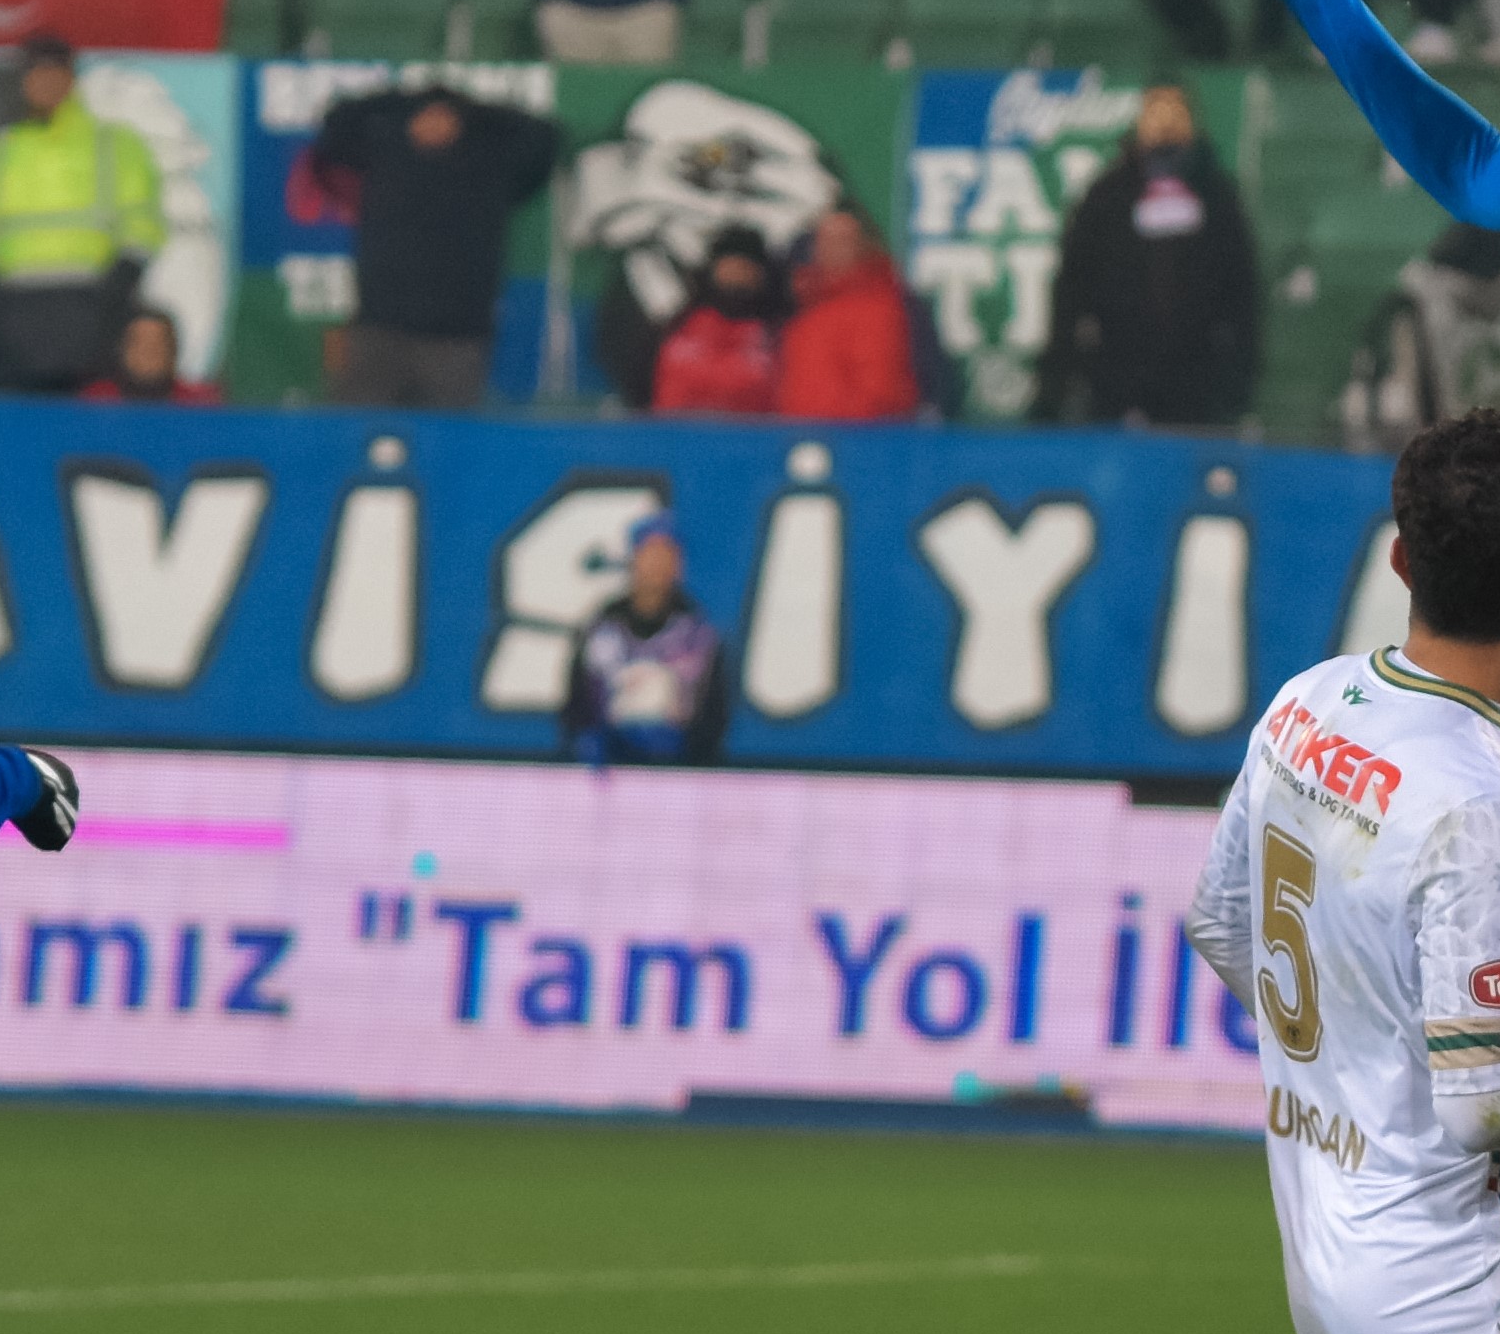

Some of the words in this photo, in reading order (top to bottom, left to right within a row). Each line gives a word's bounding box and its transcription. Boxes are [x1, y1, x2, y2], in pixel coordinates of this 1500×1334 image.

[1308, 786, 1317, 802] &
[1318, 791, 1338, 815] LPG
[1340, 803, 1381, 837] TANKS
[814, 910, 1045, 1044] Yol
[1258, 822, 1324, 1063] 5
